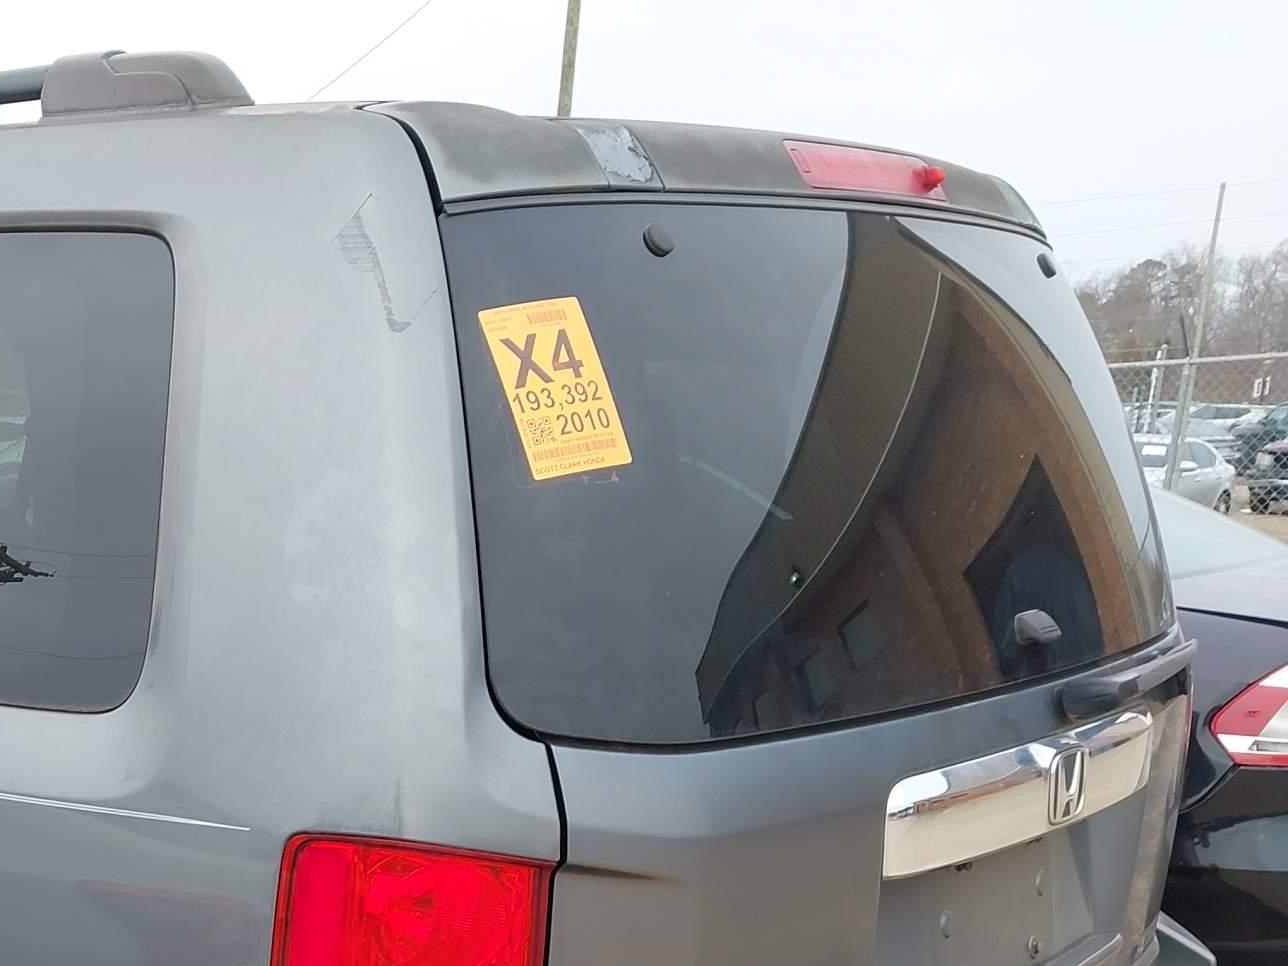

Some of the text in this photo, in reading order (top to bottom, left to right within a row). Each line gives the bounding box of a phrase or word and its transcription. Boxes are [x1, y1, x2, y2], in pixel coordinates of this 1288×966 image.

[499, 328, 585, 390] X4
[512, 380, 603, 414] 193,392
[556, 407, 611, 436] 2010
